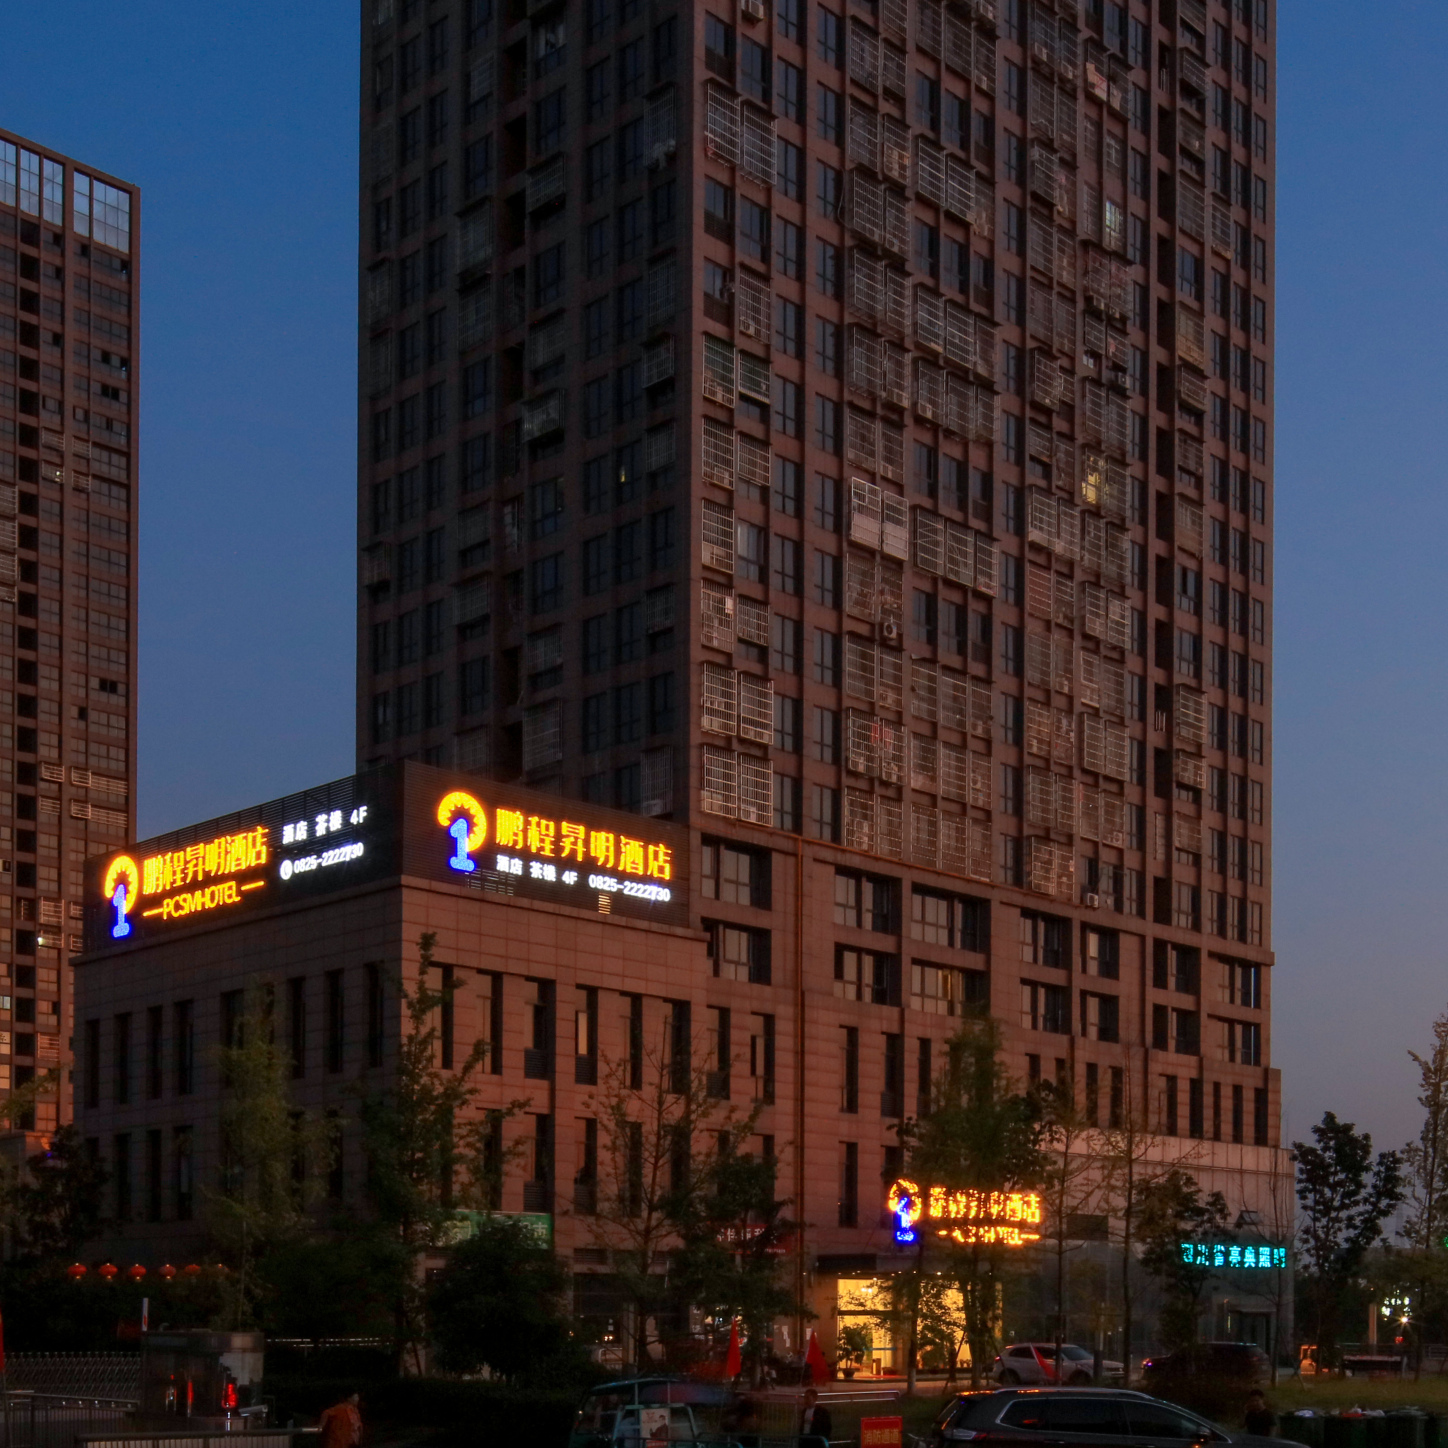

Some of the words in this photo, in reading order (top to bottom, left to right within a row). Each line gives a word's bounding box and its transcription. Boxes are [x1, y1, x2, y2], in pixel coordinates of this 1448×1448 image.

[282, 820, 308, 844] 酒店
[315, 810, 342, 837] 茶楼
[350, 805, 368, 825] 4F
[496, 854, 523, 876] 酒店
[529, 861, 556, 883] 茶楼
[562, 870, 578, 886] 4F
